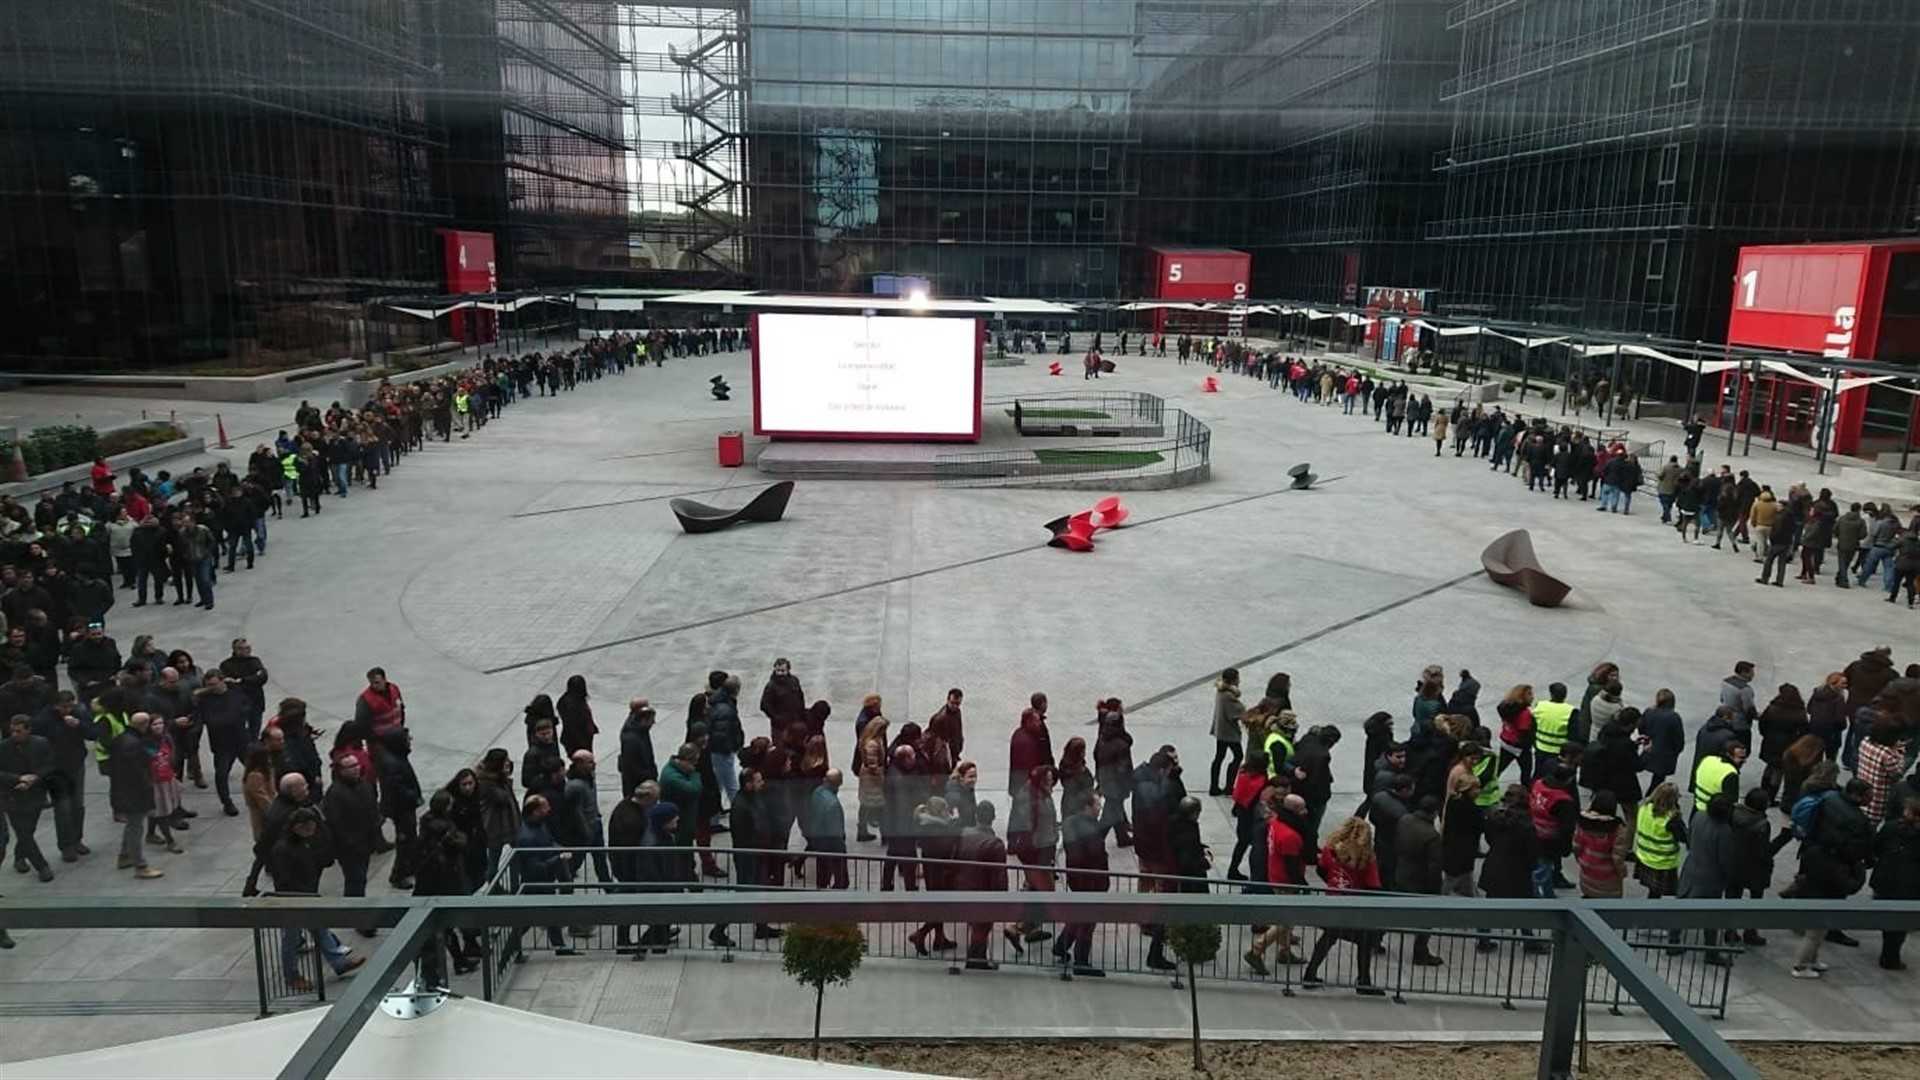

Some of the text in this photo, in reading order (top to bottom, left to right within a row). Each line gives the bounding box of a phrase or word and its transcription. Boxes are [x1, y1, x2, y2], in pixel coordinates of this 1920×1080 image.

[459, 245, 467, 269] 4
[1168, 263, 1183, 282] 5
[1742, 269, 1759, 308] 1
